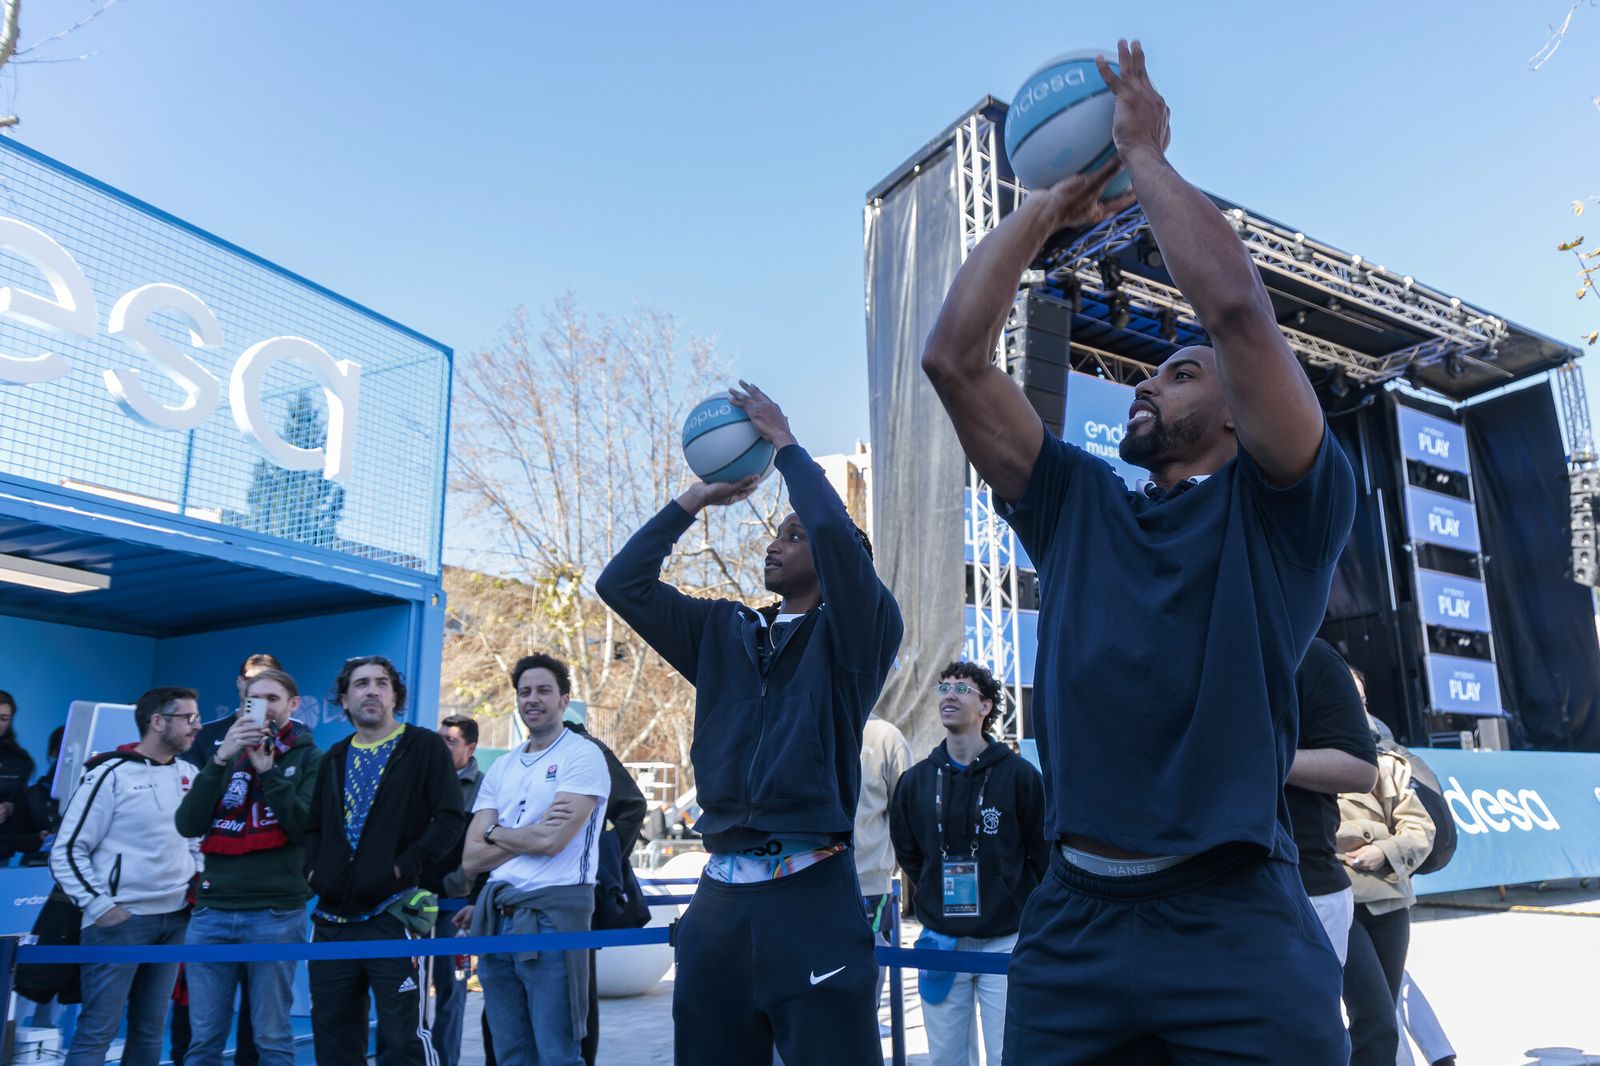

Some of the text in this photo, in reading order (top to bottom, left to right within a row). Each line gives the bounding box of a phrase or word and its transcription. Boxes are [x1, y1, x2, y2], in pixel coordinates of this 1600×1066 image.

[1418, 432, 1450, 458] PLAY
[1428, 513, 1460, 538] PLAY
[1438, 595, 1470, 619] PLAY
[1449, 679, 1480, 702] PLAY
[1443, 776, 1561, 835] desa
[1108, 864, 1157, 875] HANES
